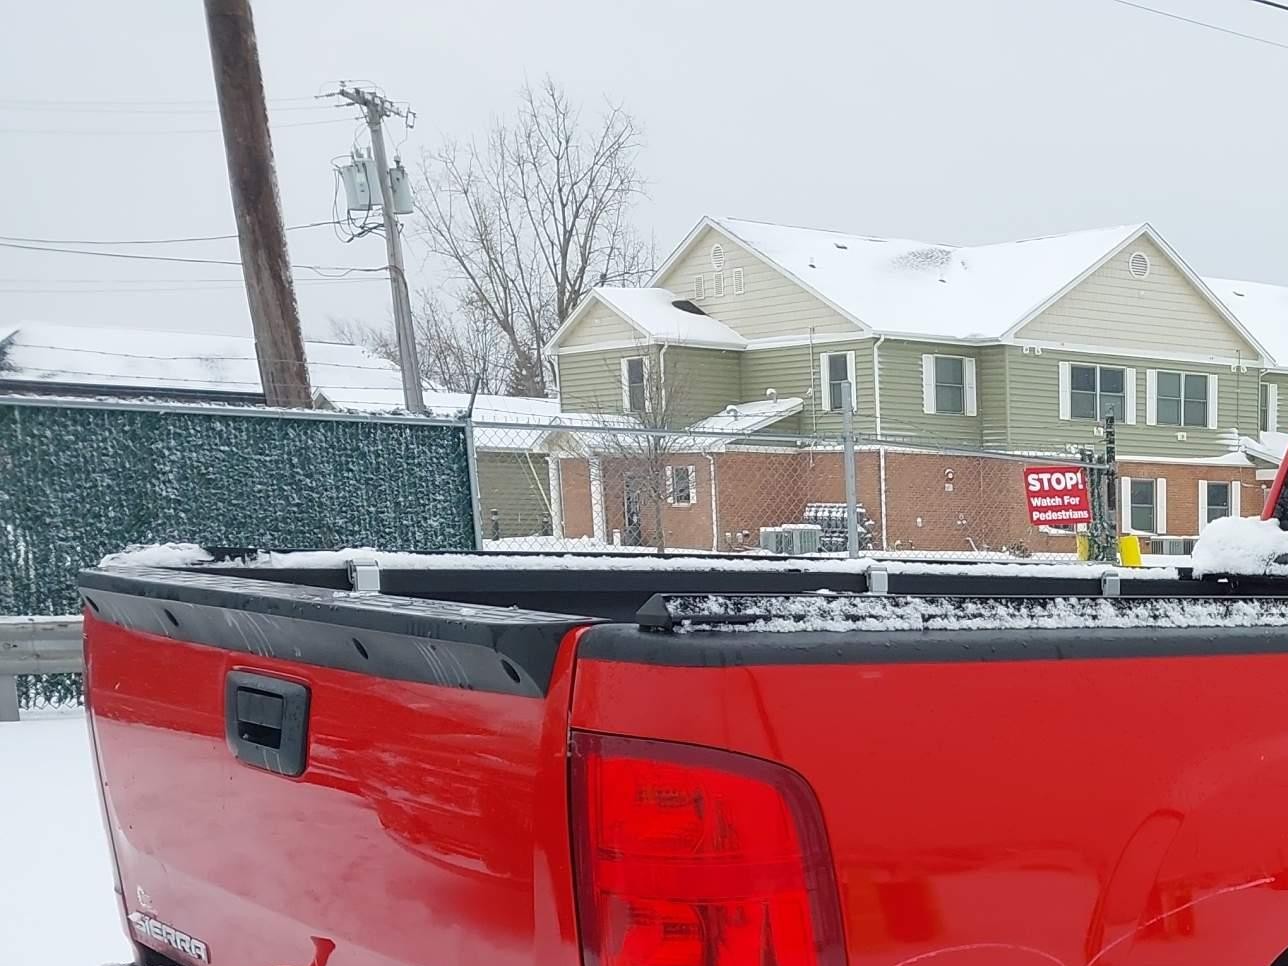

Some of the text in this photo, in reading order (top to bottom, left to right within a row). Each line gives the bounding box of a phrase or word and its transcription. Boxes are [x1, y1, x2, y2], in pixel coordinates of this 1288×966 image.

[1027, 472, 1084, 491] STOP!
[1030, 495, 1080, 507] Watch For
[1032, 509, 1089, 521] Pedestrians
